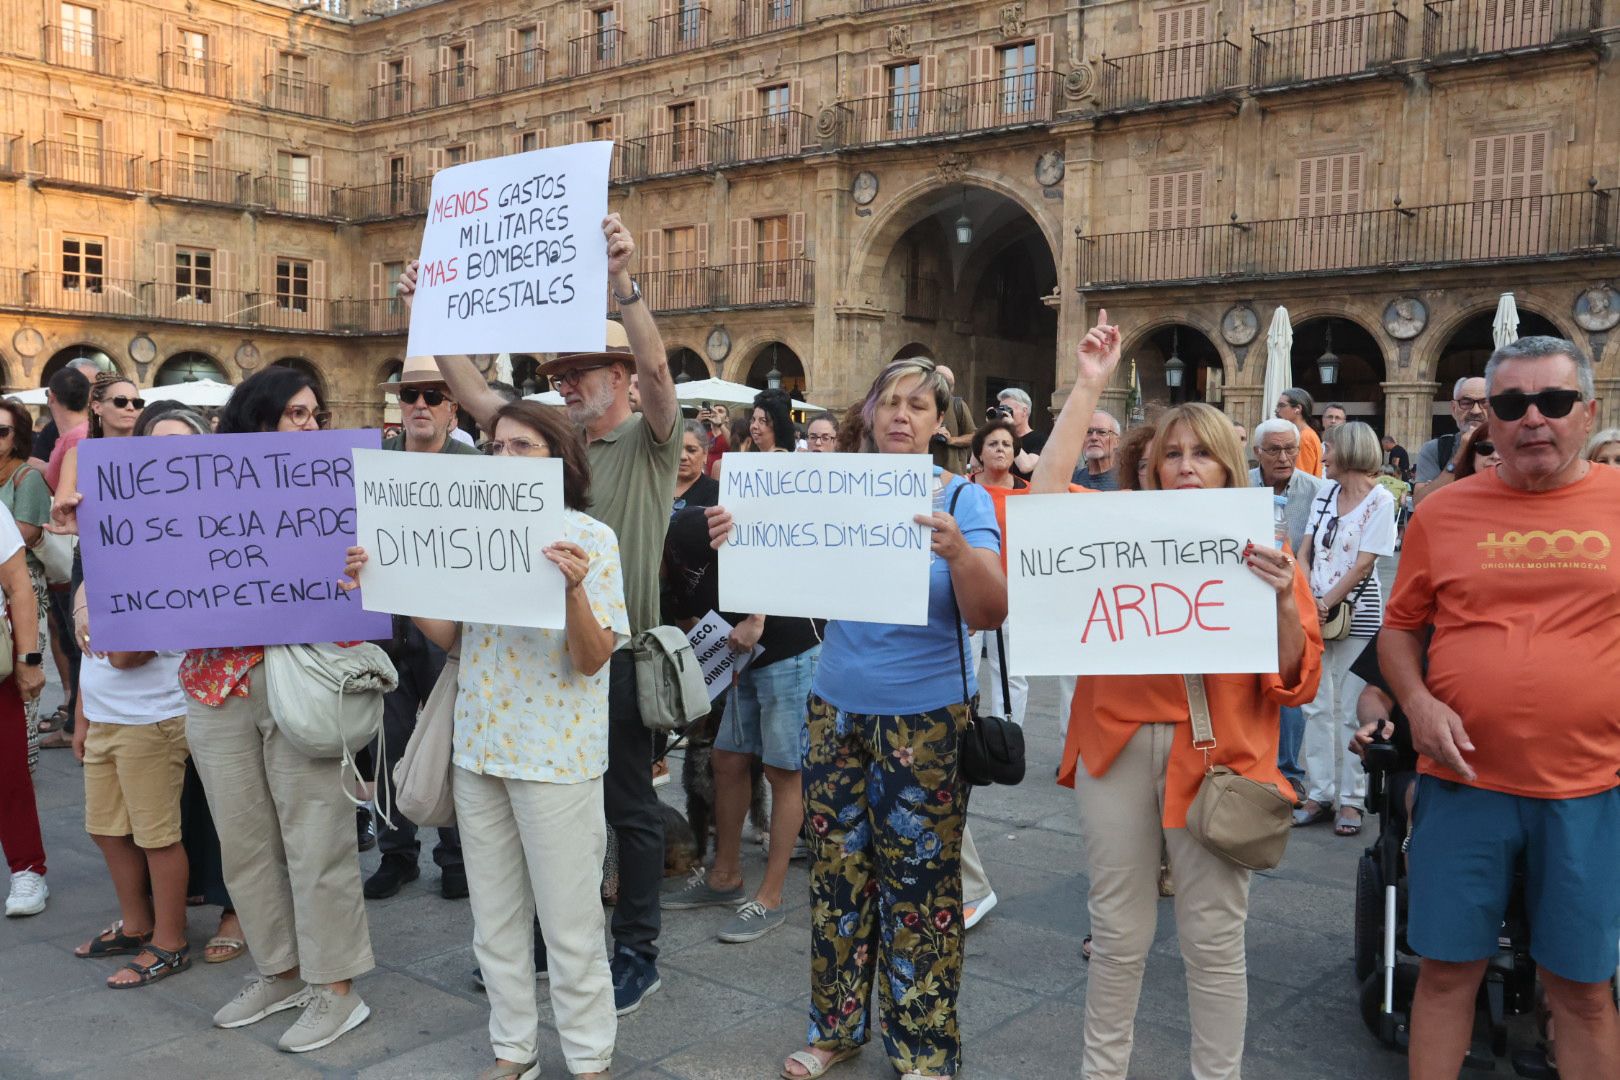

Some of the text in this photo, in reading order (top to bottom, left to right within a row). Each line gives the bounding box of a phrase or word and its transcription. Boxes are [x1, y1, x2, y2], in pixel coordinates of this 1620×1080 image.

[431, 173, 567, 225] MENOS GASTOS
[459, 204, 569, 249] MILITARES
[421, 256, 459, 288] MAS
[447, 273, 575, 320] FORESTALES
[97, 452, 355, 501] NUESTRA TIERR
[448, 479, 545, 512] QUIÑONES
[828, 468, 926, 498] DIMISIÓN
[99, 506, 357, 546] NO SE DEJA ARDE
[824, 521, 923, 550] DIMISIÓN
[209, 544, 269, 571] POR
[376, 524, 531, 573] DIMISION
[1020, 541, 1148, 577] NUESTRA
[110, 576, 351, 614] INCOMPETENCIA
[1080, 579, 1231, 644] ARDE
